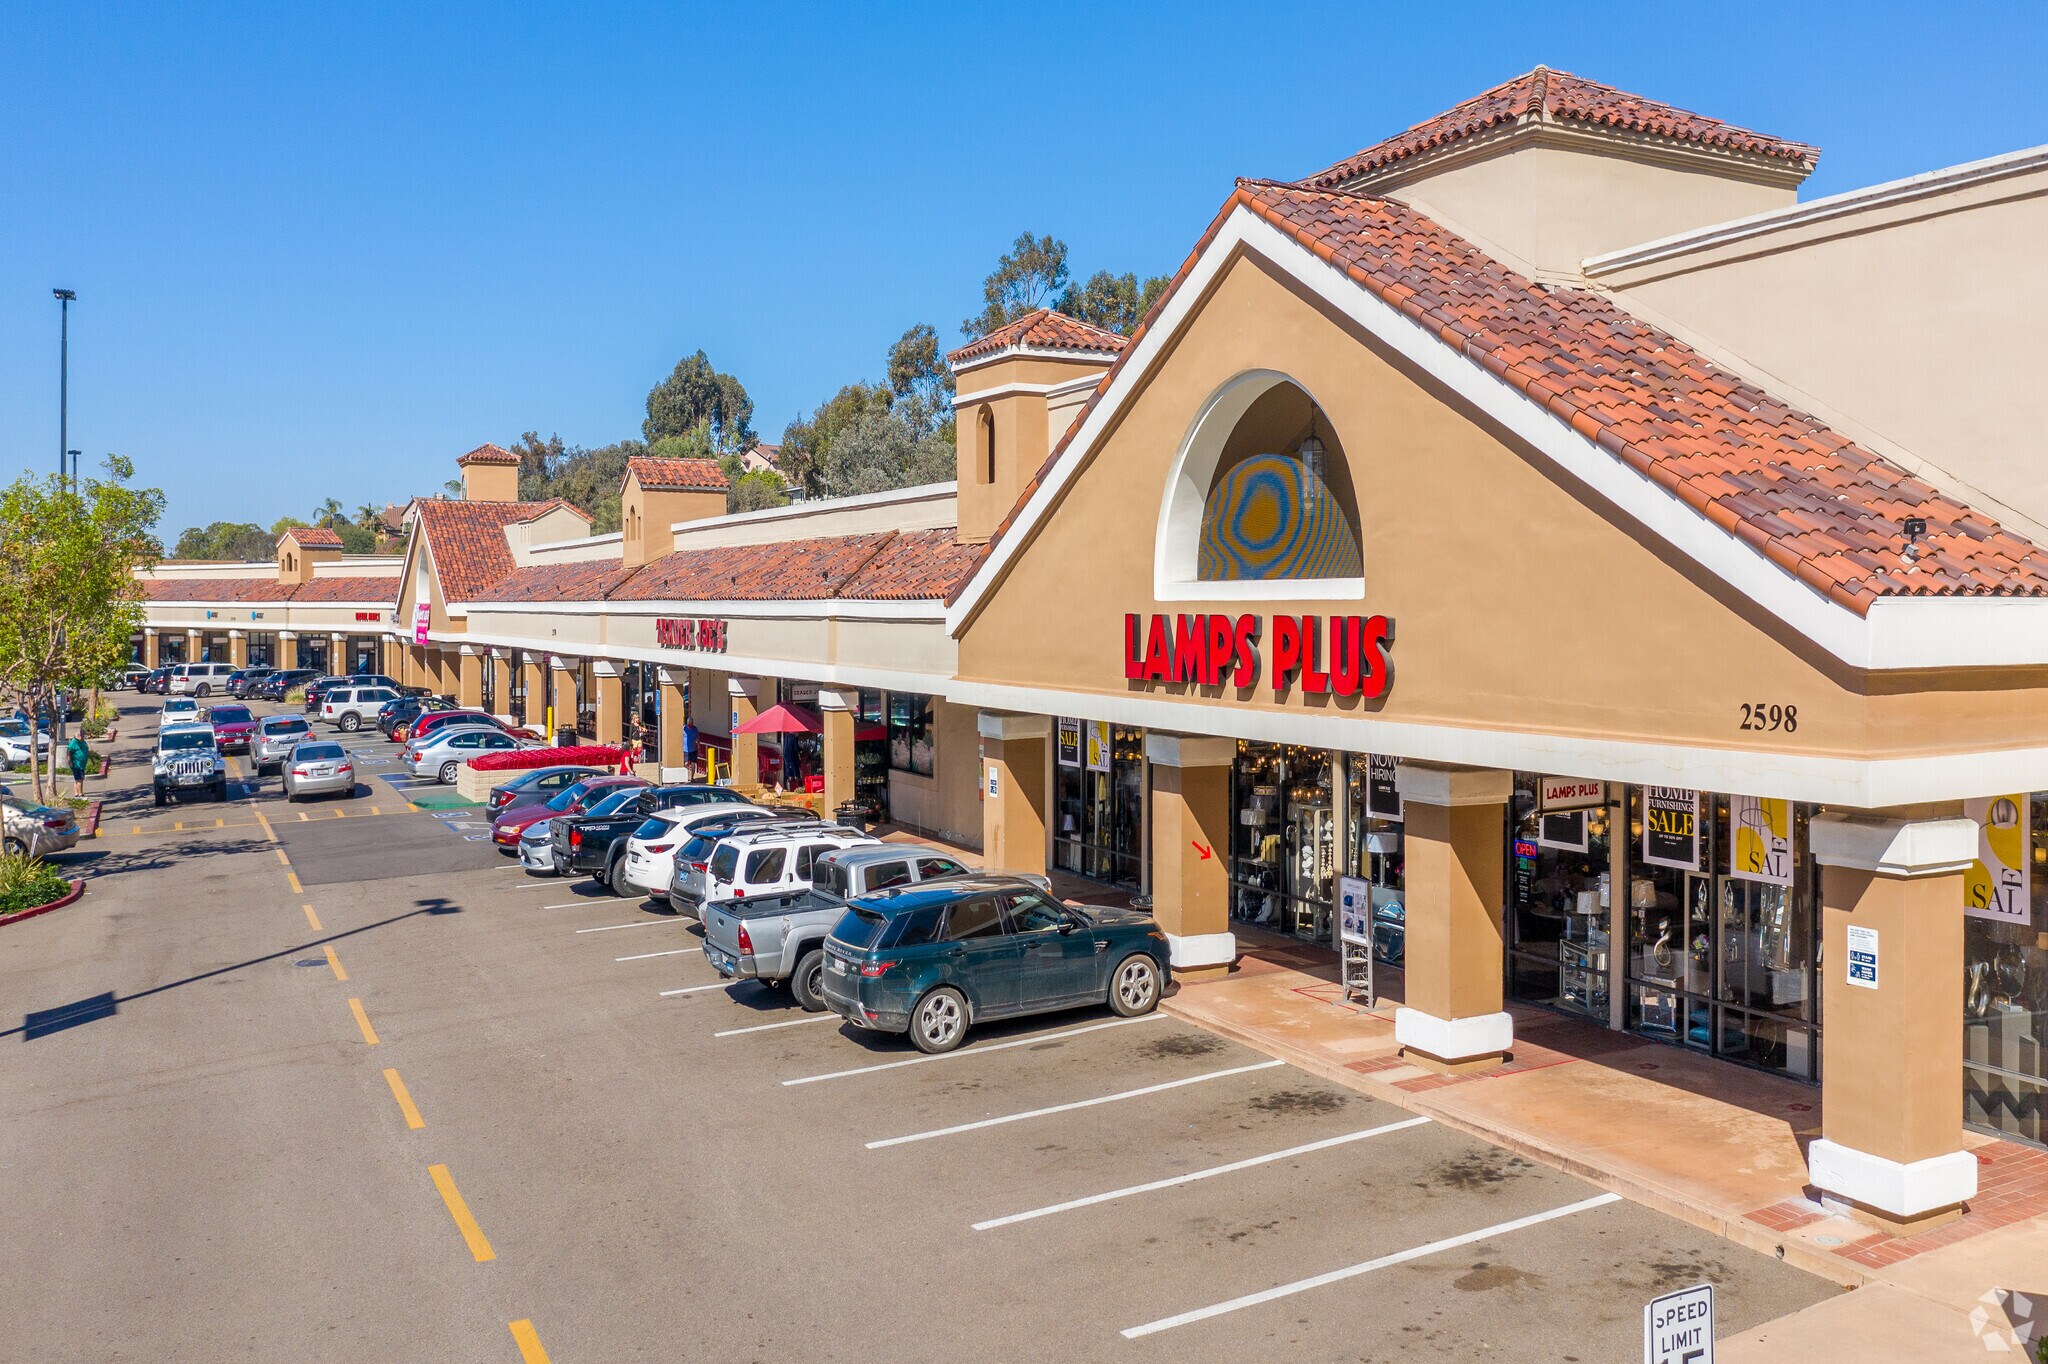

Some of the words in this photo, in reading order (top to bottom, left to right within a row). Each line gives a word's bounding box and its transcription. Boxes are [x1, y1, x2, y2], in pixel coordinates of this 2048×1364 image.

[656, 618, 695, 650] TRADER
[695, 618, 728, 653] JOE'S
[1125, 613, 1263, 690] LAMPS
[1272, 614, 1396, 699] PLUS
[1739, 702, 1798, 733] 2598
[1060, 730, 1078, 747] SALE
[1370, 753, 1398, 768] NOW
[1546, 785, 1576, 800] LAMPS
[1578, 782, 1599, 797] PLUS
[1648, 799, 1695, 812] FURNISHINGS
[1648, 809, 1694, 836] SALE
[1515, 842, 1537, 857] OPEN
[1656, 1300, 1708, 1329] SPEED
[1662, 1327, 1702, 1354] LIMIT
